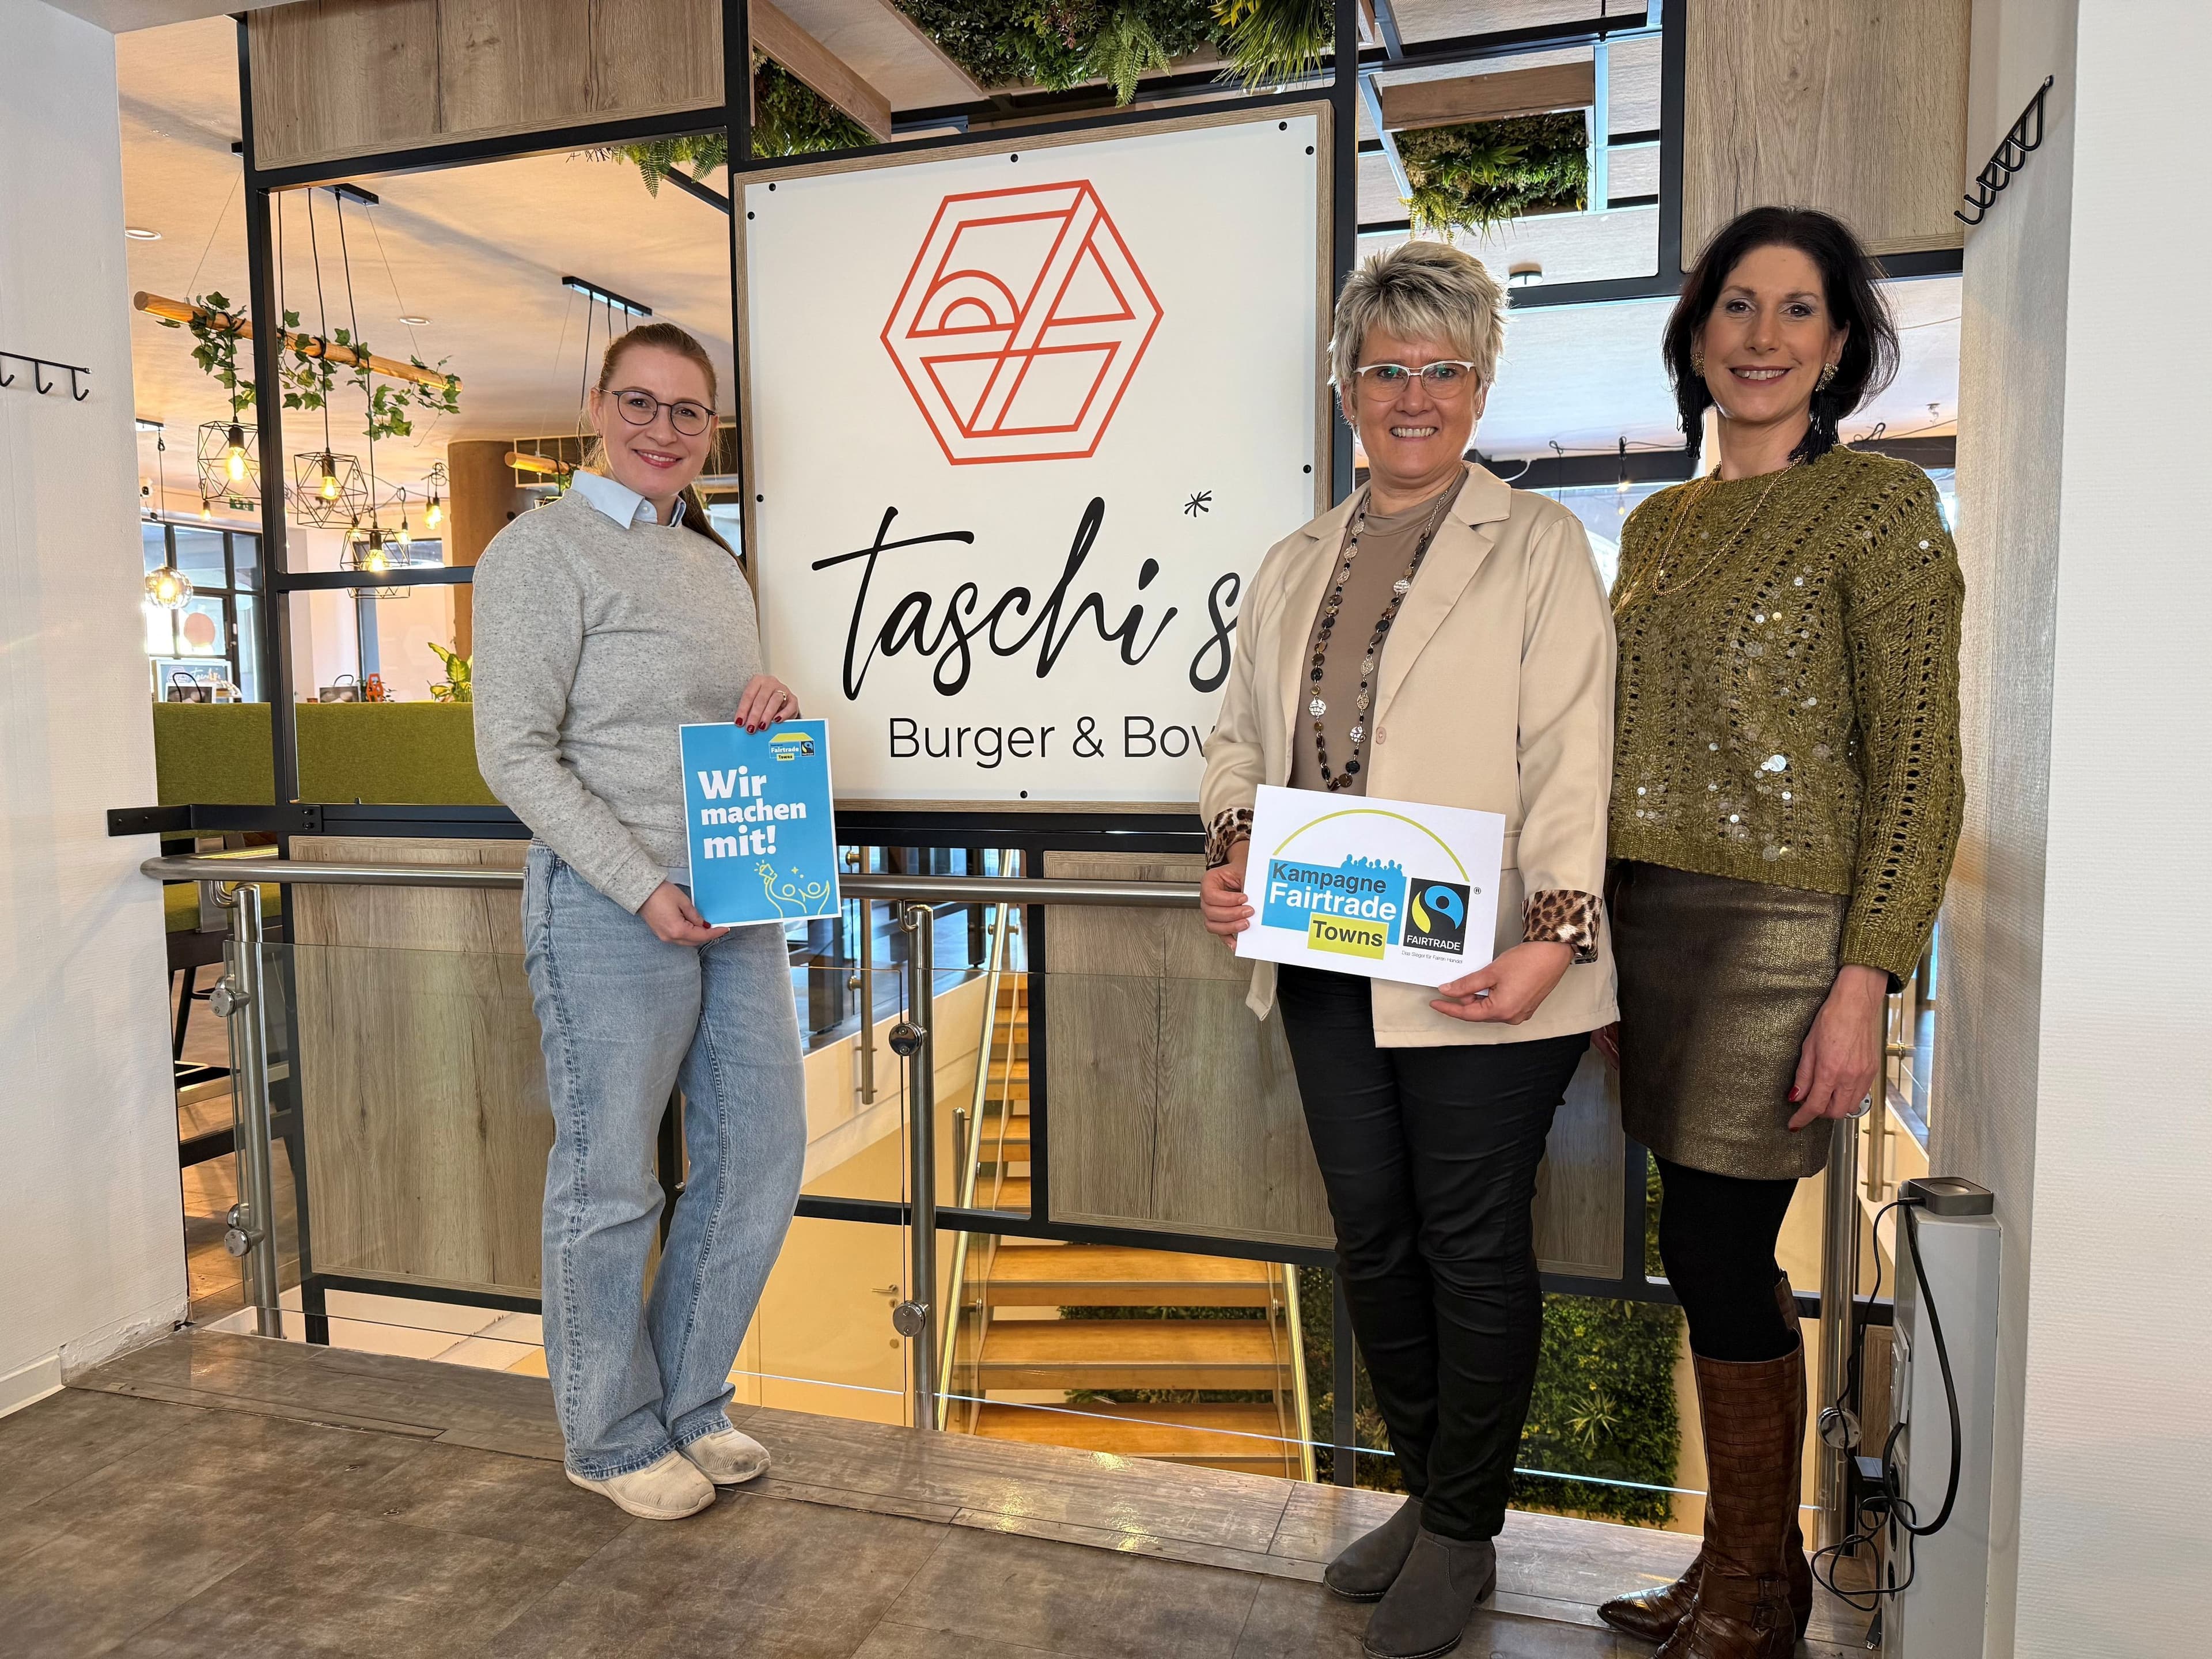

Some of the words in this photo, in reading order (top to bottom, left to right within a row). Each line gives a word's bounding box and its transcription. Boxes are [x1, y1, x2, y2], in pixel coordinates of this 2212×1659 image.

[889, 717, 1055, 769] Burger
[1073, 716, 1104, 758] &
[697, 766, 767, 800] Wir
[700, 798, 807, 825] machen
[703, 824, 777, 859] mit!
[1272, 862, 1387, 894] Kampagne
[1269, 881, 1397, 921] Fairtrade
[1313, 920, 1383, 947] Towns
[1407, 934, 1461, 951] FAIRTRADE
